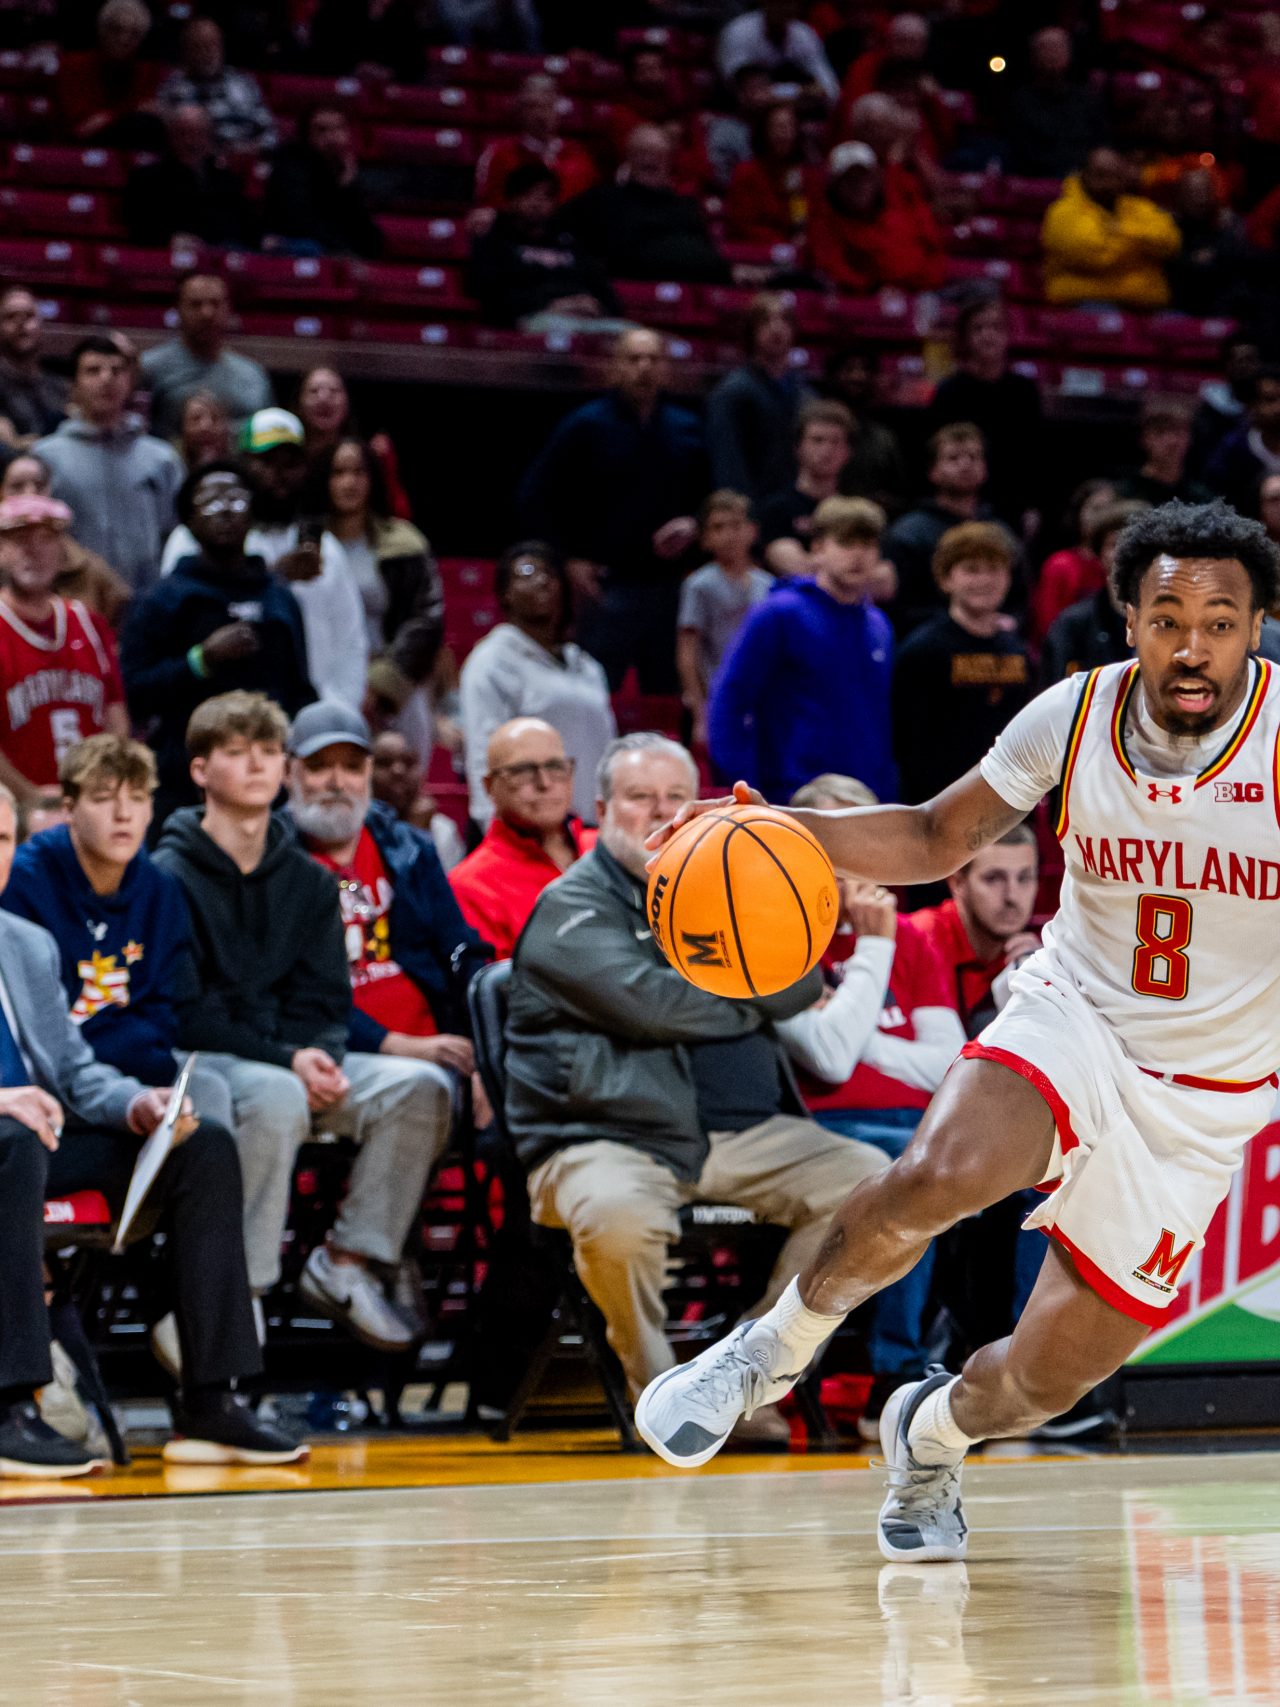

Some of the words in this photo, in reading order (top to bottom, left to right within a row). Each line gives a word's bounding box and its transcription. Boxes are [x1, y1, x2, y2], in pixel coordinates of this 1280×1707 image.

[680, 929, 726, 969] M
[1131, 893, 1193, 1001] 8
[1136, 1228, 1195, 1287] M
